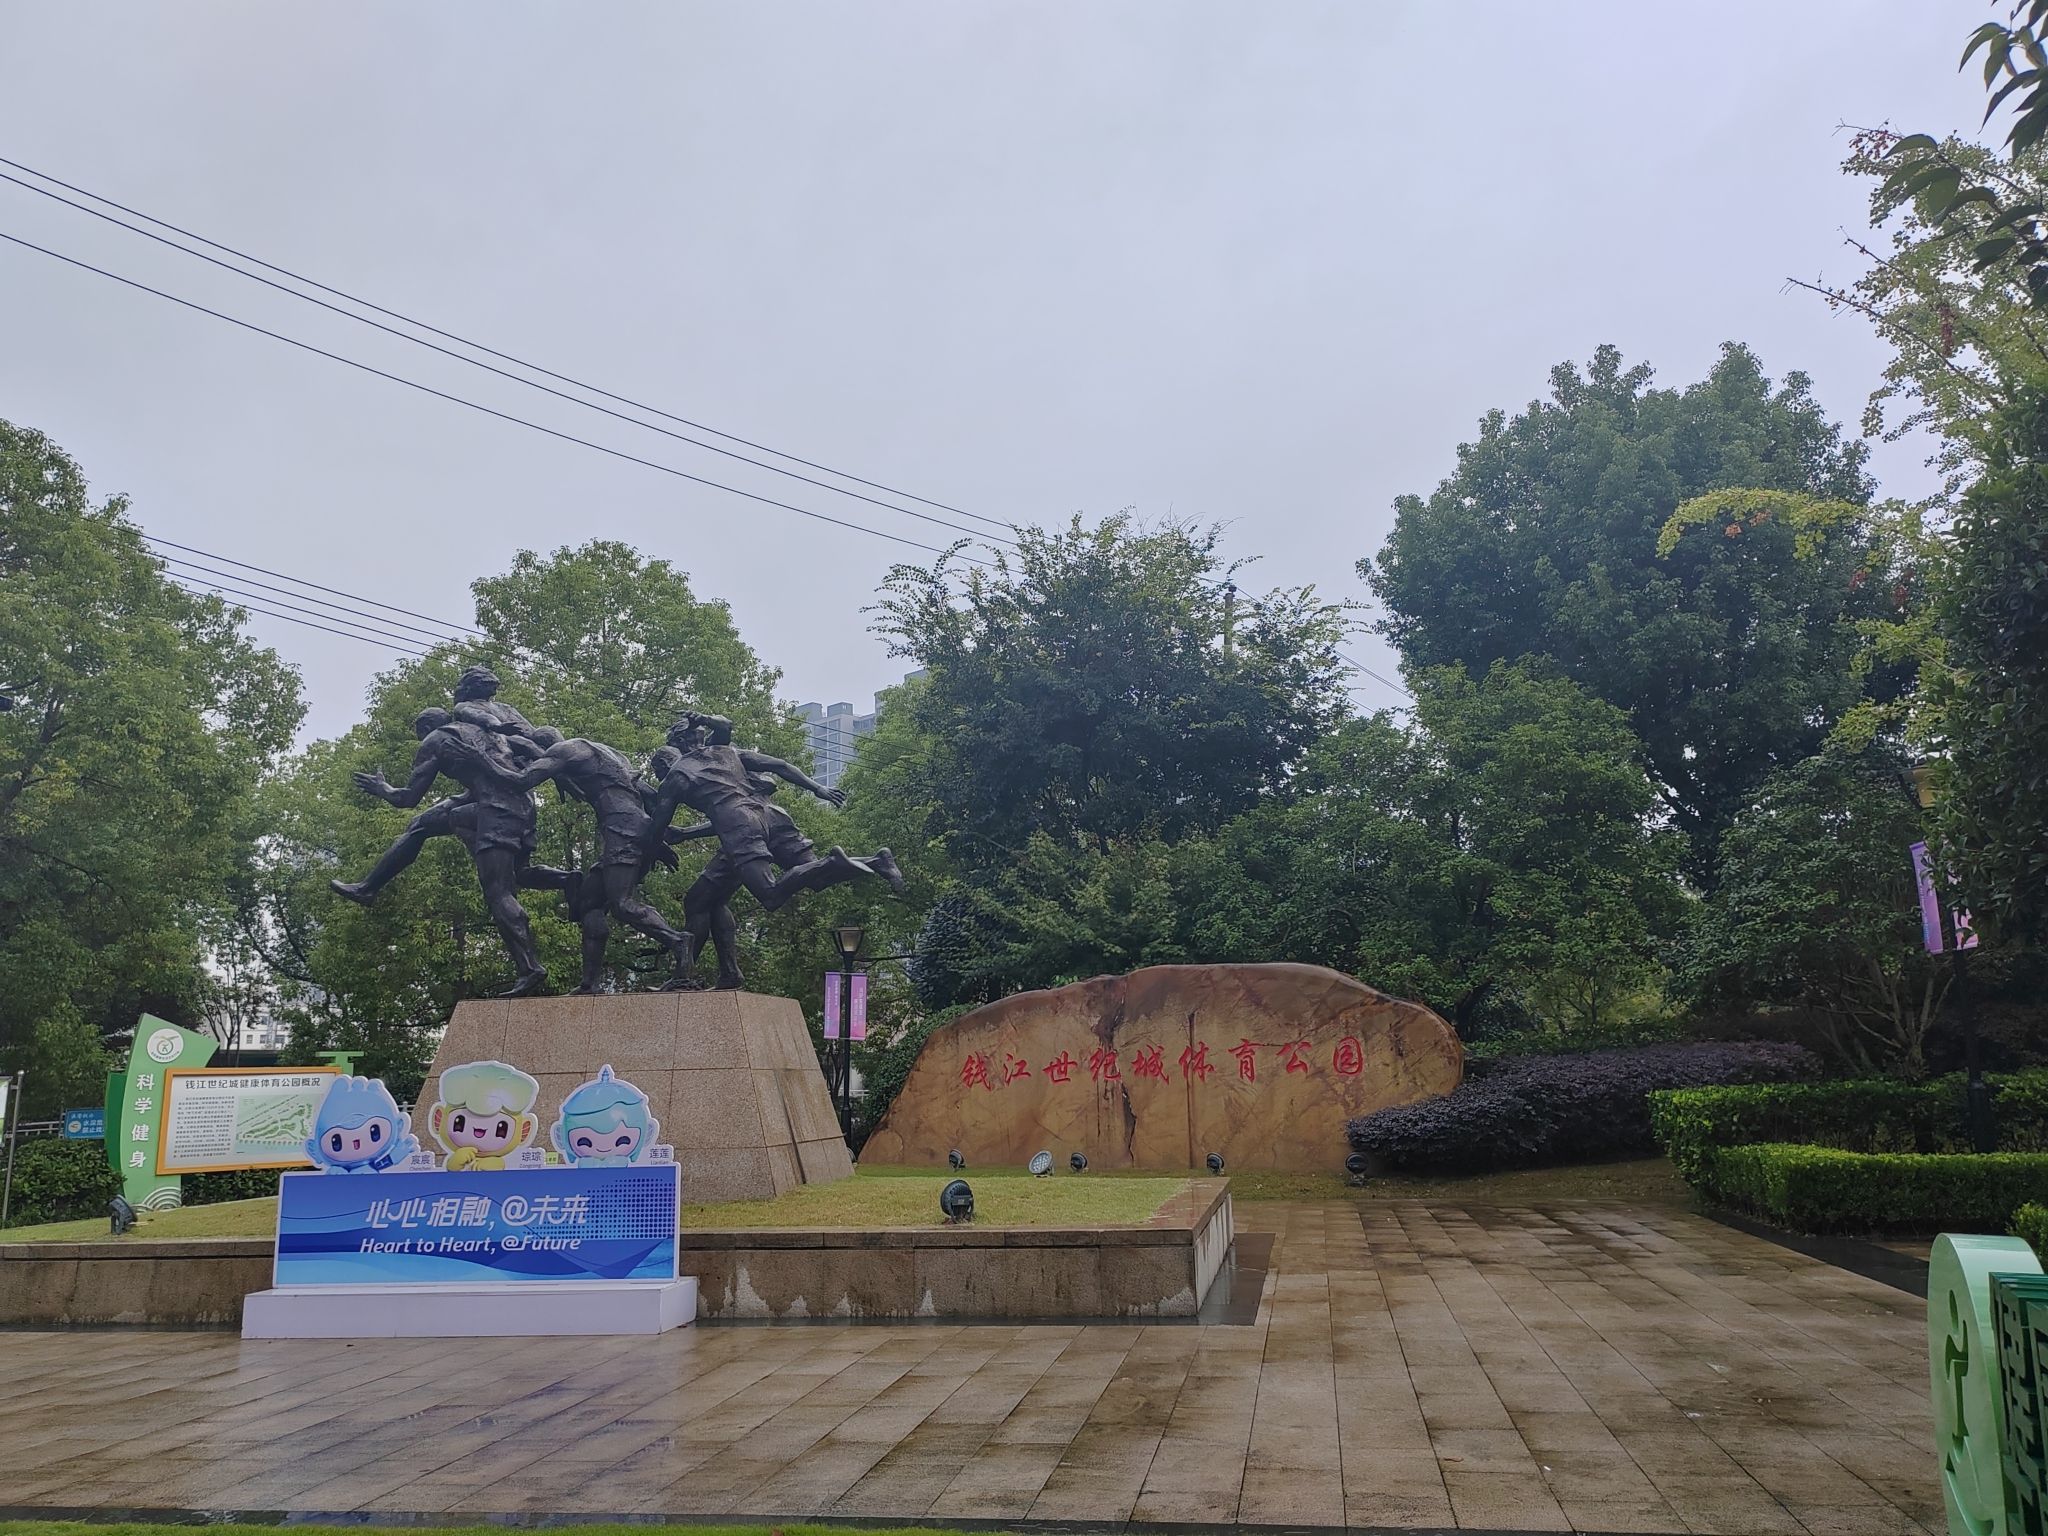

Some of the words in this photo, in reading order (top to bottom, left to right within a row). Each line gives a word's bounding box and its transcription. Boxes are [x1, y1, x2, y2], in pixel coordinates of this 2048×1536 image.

[959, 1036, 1365, 1092] 钱江世纪城体育公园
[185, 1077, 321, 1090] 钱江世纪城健康体育公园概况
[129, 1073, 154, 1168] 科学健身
[649, 1148, 670, 1158] 莲莲
[360, 1238, 411, 1254] Heart
[416, 1238, 435, 1253] to
[439, 1236, 496, 1255] Heart,
[501, 1234, 582, 1252] @Future
